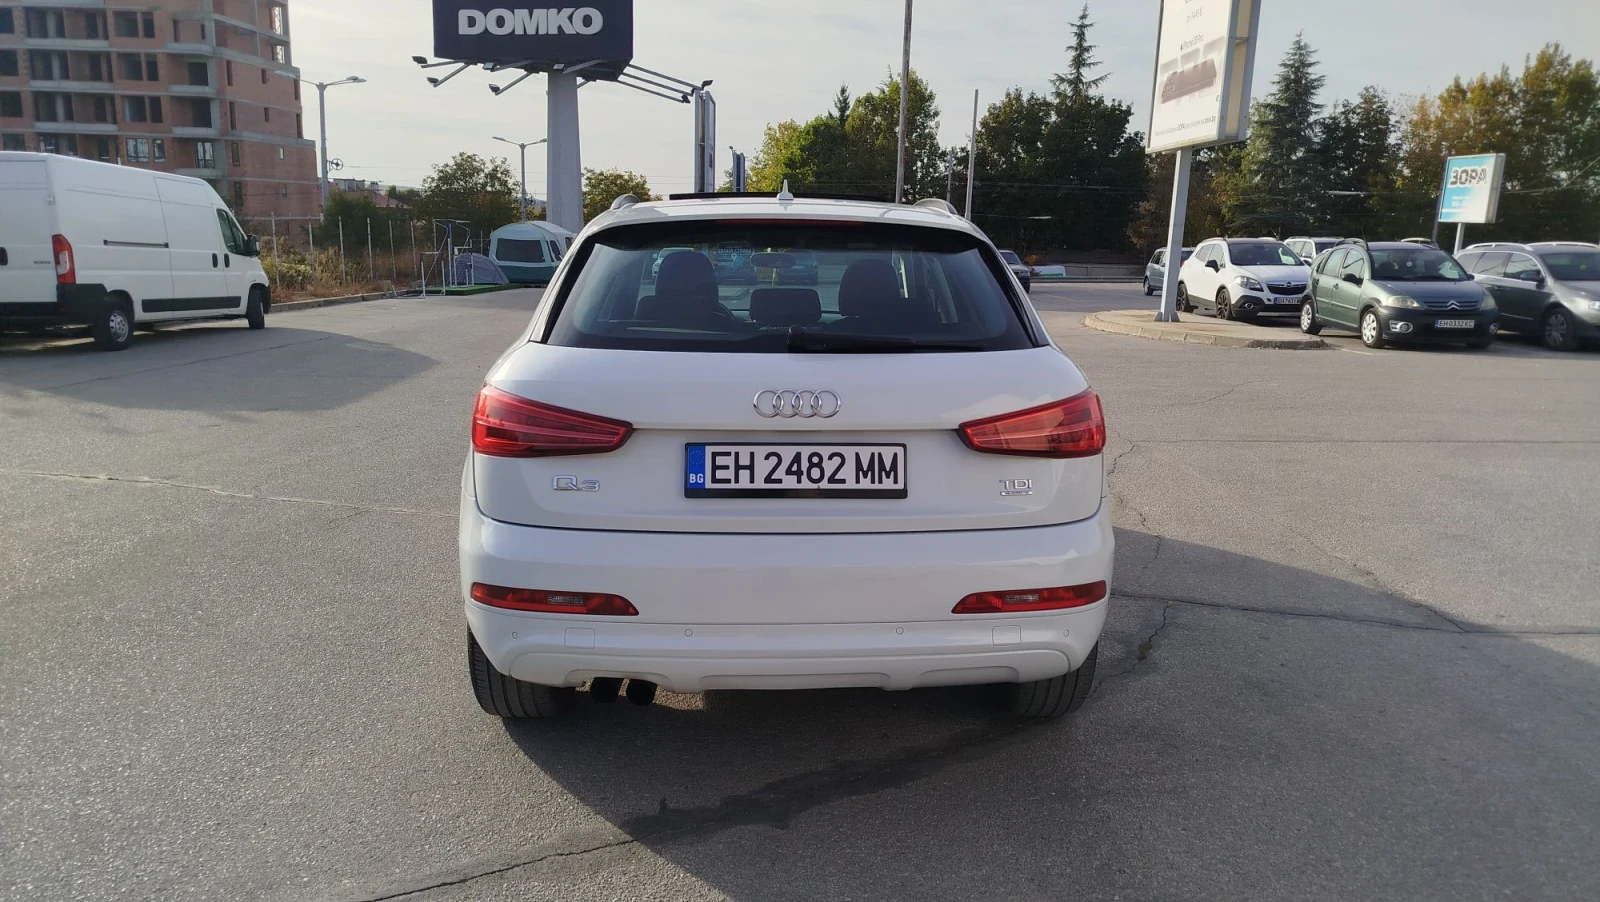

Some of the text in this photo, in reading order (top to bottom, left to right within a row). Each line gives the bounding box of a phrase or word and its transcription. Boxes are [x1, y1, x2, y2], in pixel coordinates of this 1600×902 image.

[458, 7, 603, 36] DOMKO
[1450, 168, 1487, 185] ЗОРА
[711, 452, 898, 484] EH 2482 MM
[552, 475, 600, 492] Q3
[690, 473, 704, 484] BG
[999, 479, 1032, 490] TDI
